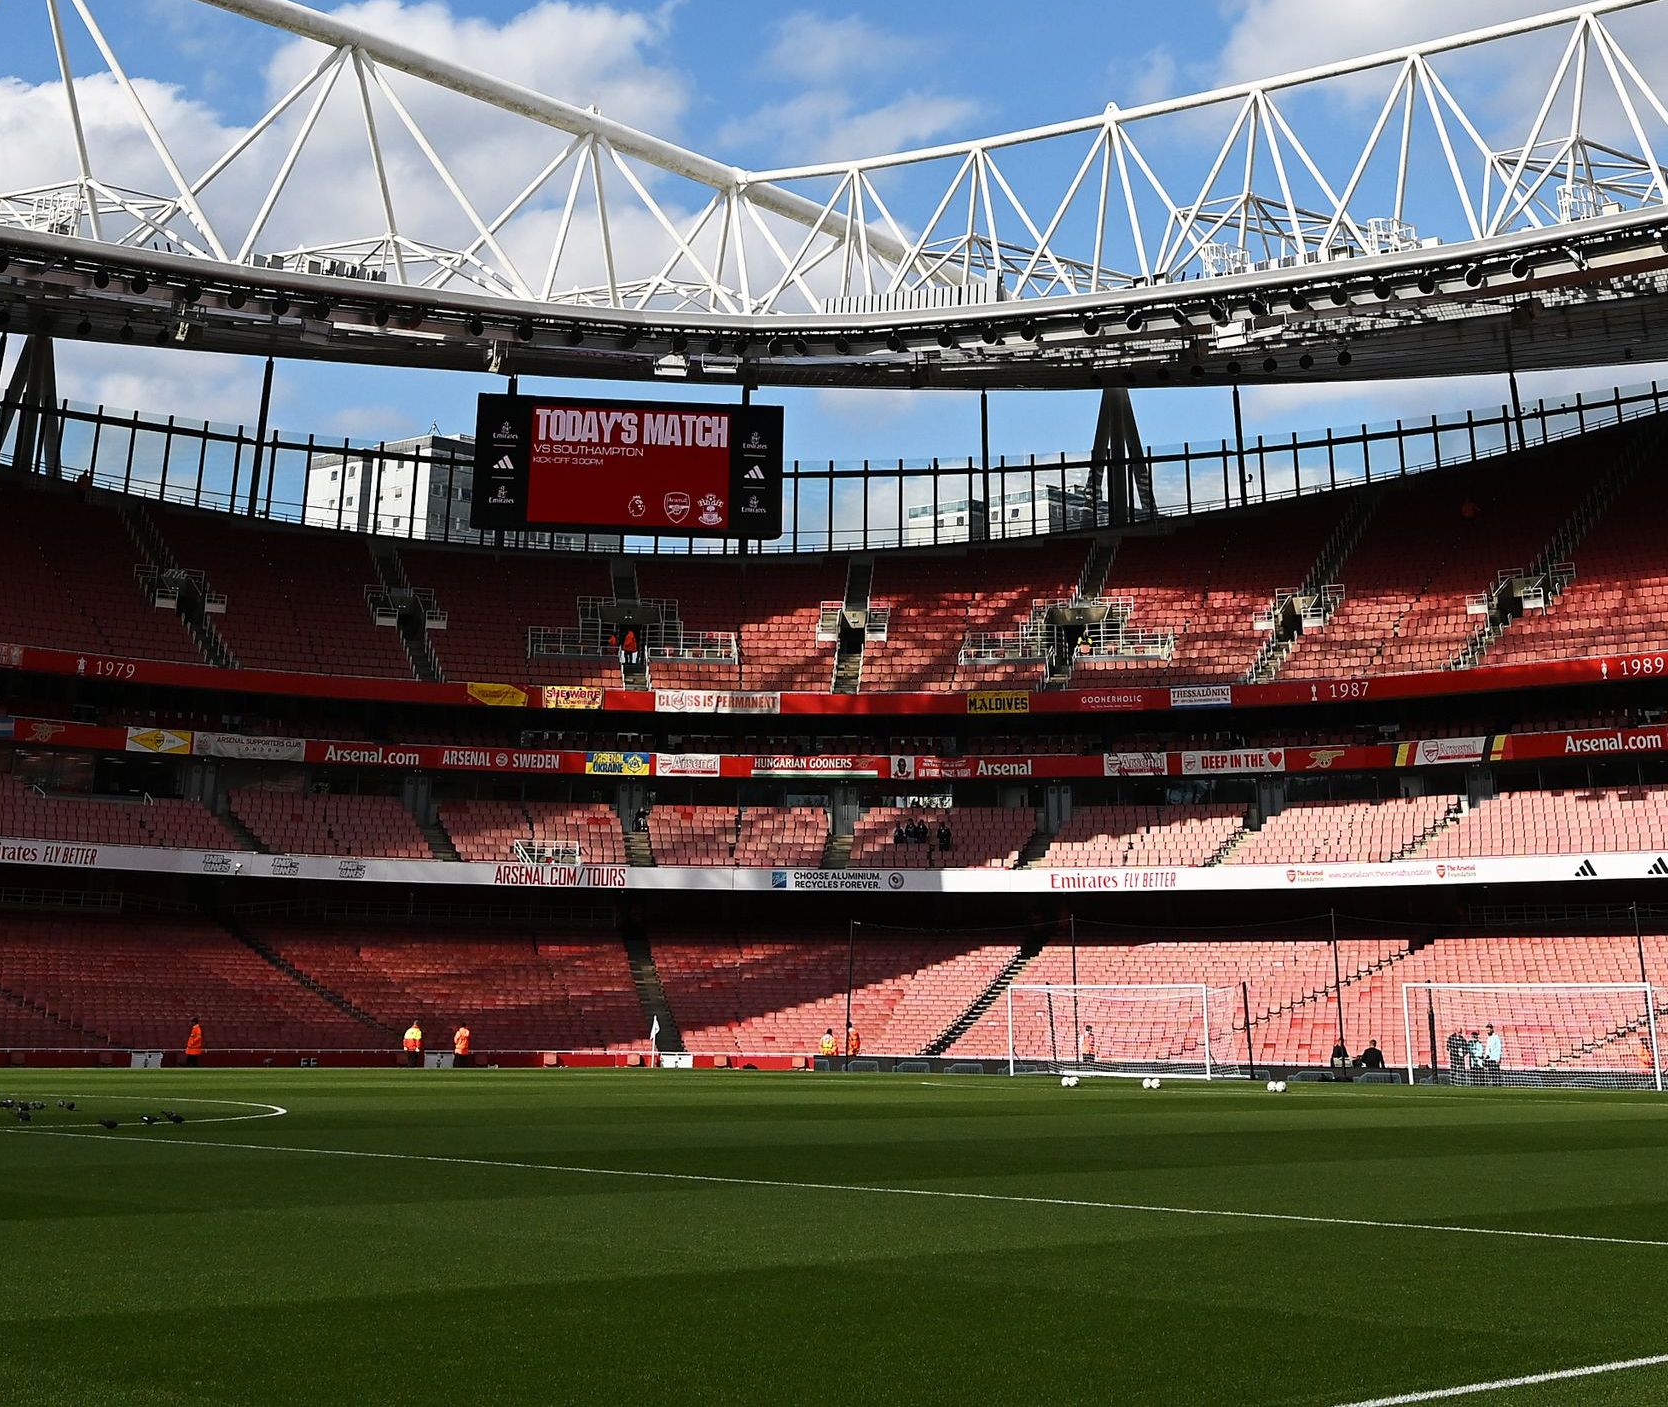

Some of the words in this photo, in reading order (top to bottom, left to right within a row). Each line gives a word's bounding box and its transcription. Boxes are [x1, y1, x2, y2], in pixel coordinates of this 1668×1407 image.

[536, 408, 638, 444] TODAY'S
[643, 413, 729, 448] MATCH
[534, 444, 551, 454] VS
[553, 444, 644, 457] SOUTHAMPTON
[533, 456, 571, 464] KICK-OFF
[95, 659, 136, 680] 1979
[1620, 657, 1665, 676] 1989
[546, 690, 567, 698] SHE
[1329, 681, 1369, 699] 1987
[658, 694, 701, 709] CLSS
[703, 694, 714, 707] IS
[716, 695, 778, 708] PERMANENT
[969, 697, 1028, 711] MALDIVES
[1081, 695, 1142, 703] GOONERHOLIC
[216, 736, 246, 745] ARSENAL
[246, 738, 284, 747] SUPPORTERS
[285, 740, 302, 748] CLUB
[1439, 741, 1478, 755] Arsenal
[1564, 732, 1662, 754] Arsenal.com
[324, 745, 420, 765] Arsenal.com
[442, 751, 491, 767] ARSENAL
[512, 752, 560, 769] SWEDEN
[592, 753, 624, 763] ARSENAL
[1120, 755, 1164, 769] Arsenal
[1201, 755, 1228, 769] DEEP
[1230, 754, 1241, 768] IN
[1243, 753, 1265, 767] THE
[592, 762, 624, 773] UKRAINE
[672, 756, 718, 769] Arsenal
[754, 758, 806, 768] HUNGARIAN
[809, 758, 853, 768] GOONERS
[976, 759, 1032, 776] Arsenal
[42, 845, 62, 863] FLY
[62, 847, 98, 865] BETTER
[494, 865, 626, 887] ARSENAL.COM/TOURS
[793, 872, 829, 880] CHOOSE
[831, 872, 882, 880] ALUMINIUM.
[1050, 873, 1118, 889] Emirates
[1124, 872, 1140, 888] FLY
[1142, 872, 1176, 887] BETTER
[794, 880, 838, 889] RECYCLES
[840, 880, 881, 889] FOREVER.
